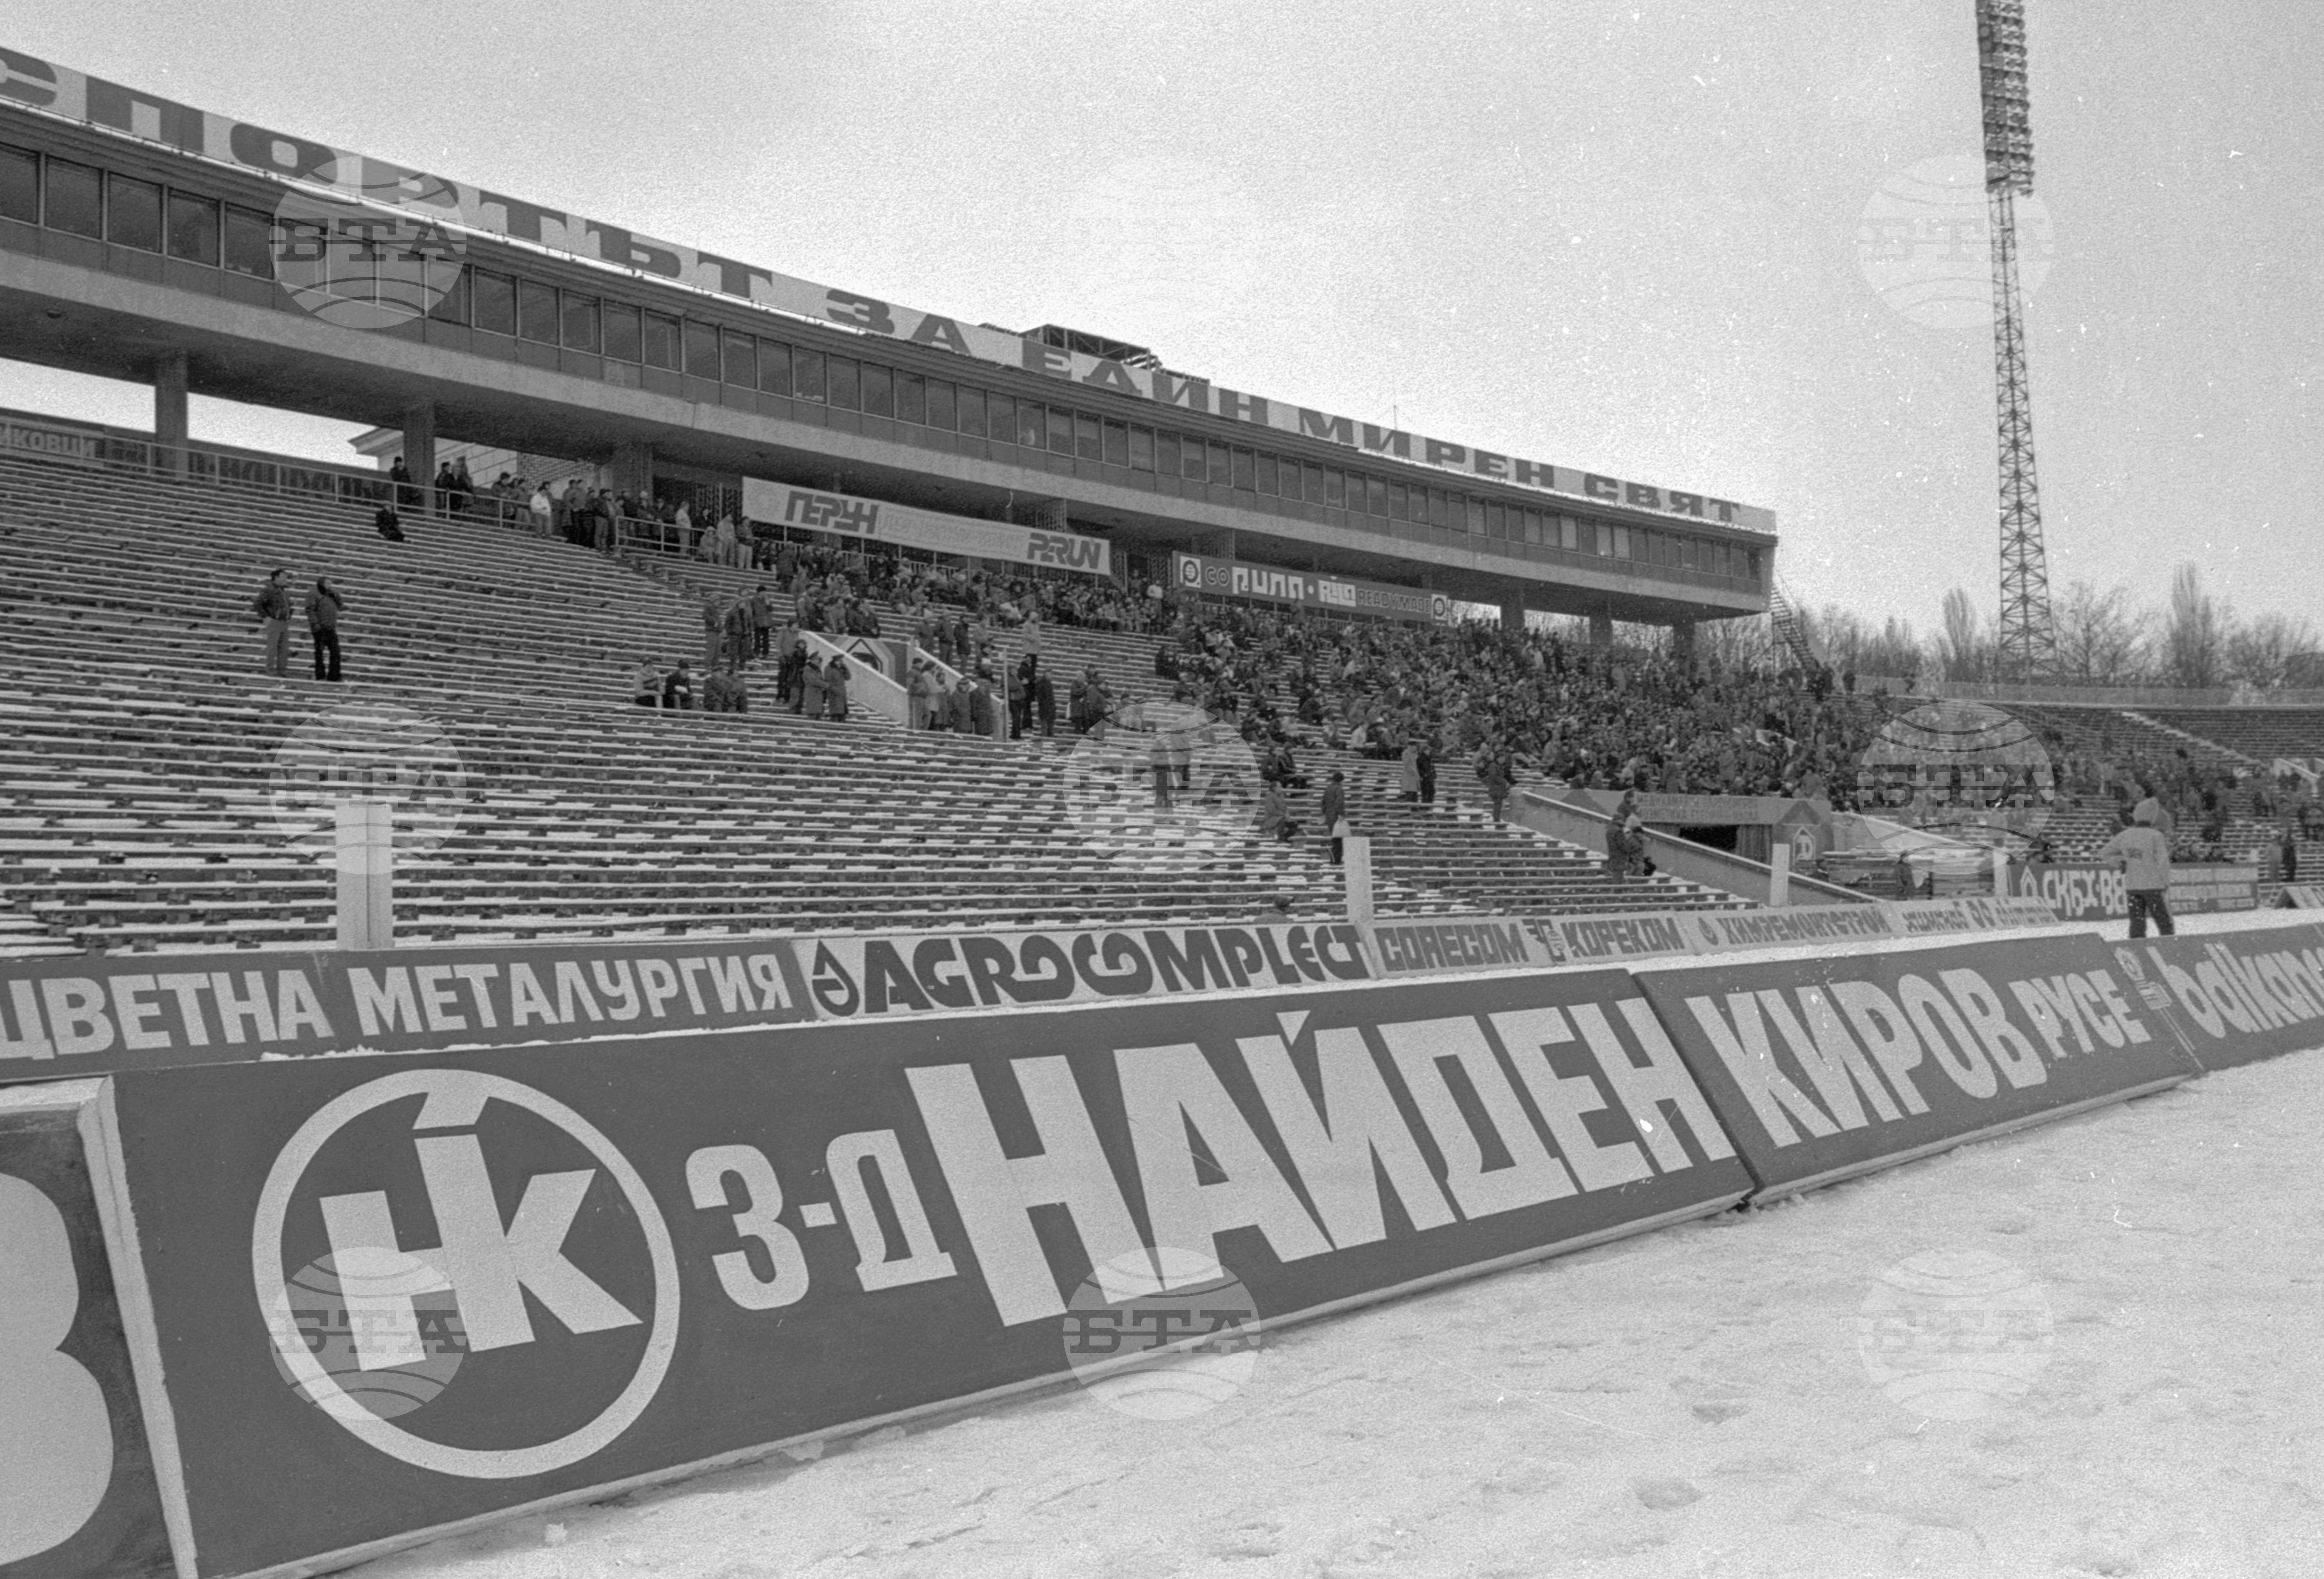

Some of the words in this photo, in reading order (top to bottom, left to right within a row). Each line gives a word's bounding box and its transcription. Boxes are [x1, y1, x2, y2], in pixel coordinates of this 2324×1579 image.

[826, 289, 971, 358] ЗА
[1022, 339, 1268, 425] ЕДИН
[1299, 407, 1555, 489] МИРЕН
[1584, 472, 1740, 522] СВЯТ
[1027, 532, 1102, 569] PERUN
[865, 924, 1371, 1014] AGROCOMPLECT
[1373, 923, 1530, 972] CORECOM
[1560, 917, 1685, 958] КОРЕКОМ
[0, 970, 335, 1060] ЦВЕТНА
[347, 954, 793, 1036] МЕТАЛУРГИЯ
[904, 997, 1738, 1327] НАЙДЕН
[1684, 968, 2047, 1149] КИРОВ
[2009, 968, 2151, 1058] РУСЕ
